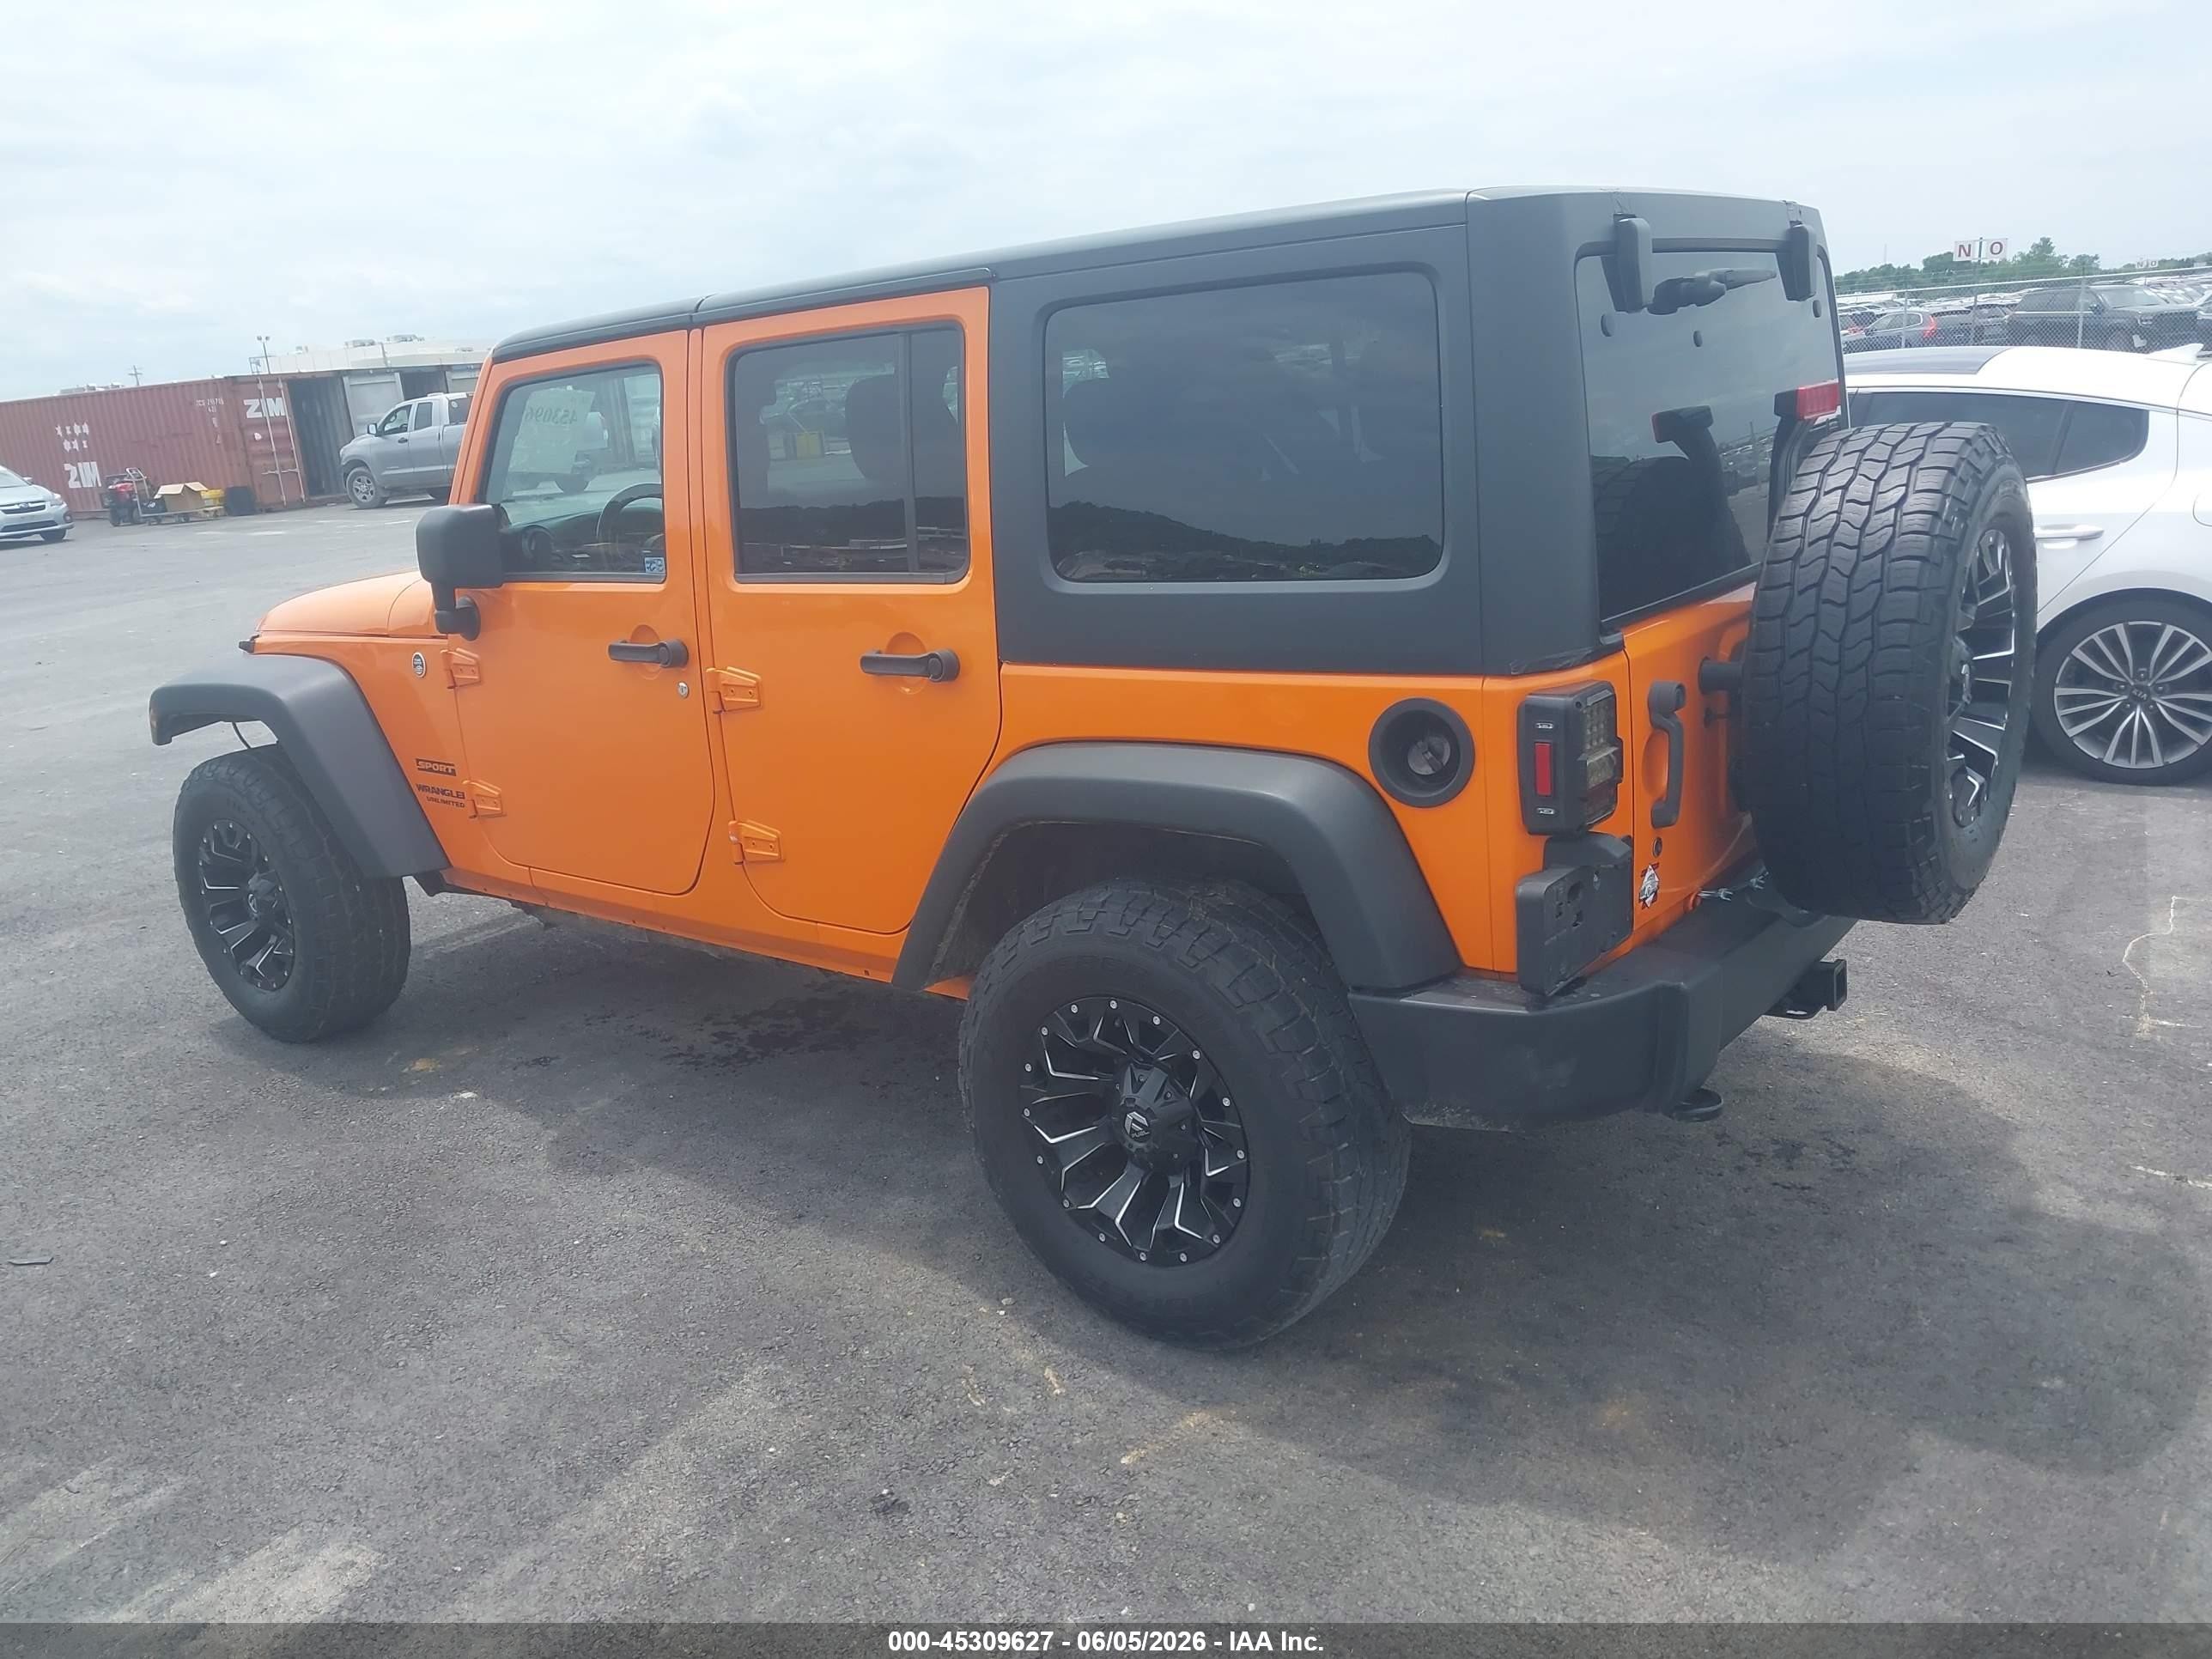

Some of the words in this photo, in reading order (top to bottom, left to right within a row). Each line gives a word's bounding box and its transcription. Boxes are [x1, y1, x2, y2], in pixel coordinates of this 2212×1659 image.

[1958, 244, 1972, 258] N
[243, 398, 286, 418] ZIM
[64, 461, 101, 489] ZIM
[2132, 689, 2147, 700] KIA
[417, 761, 455, 774] SPORT
[426, 796, 465, 808] UNLIMITED
